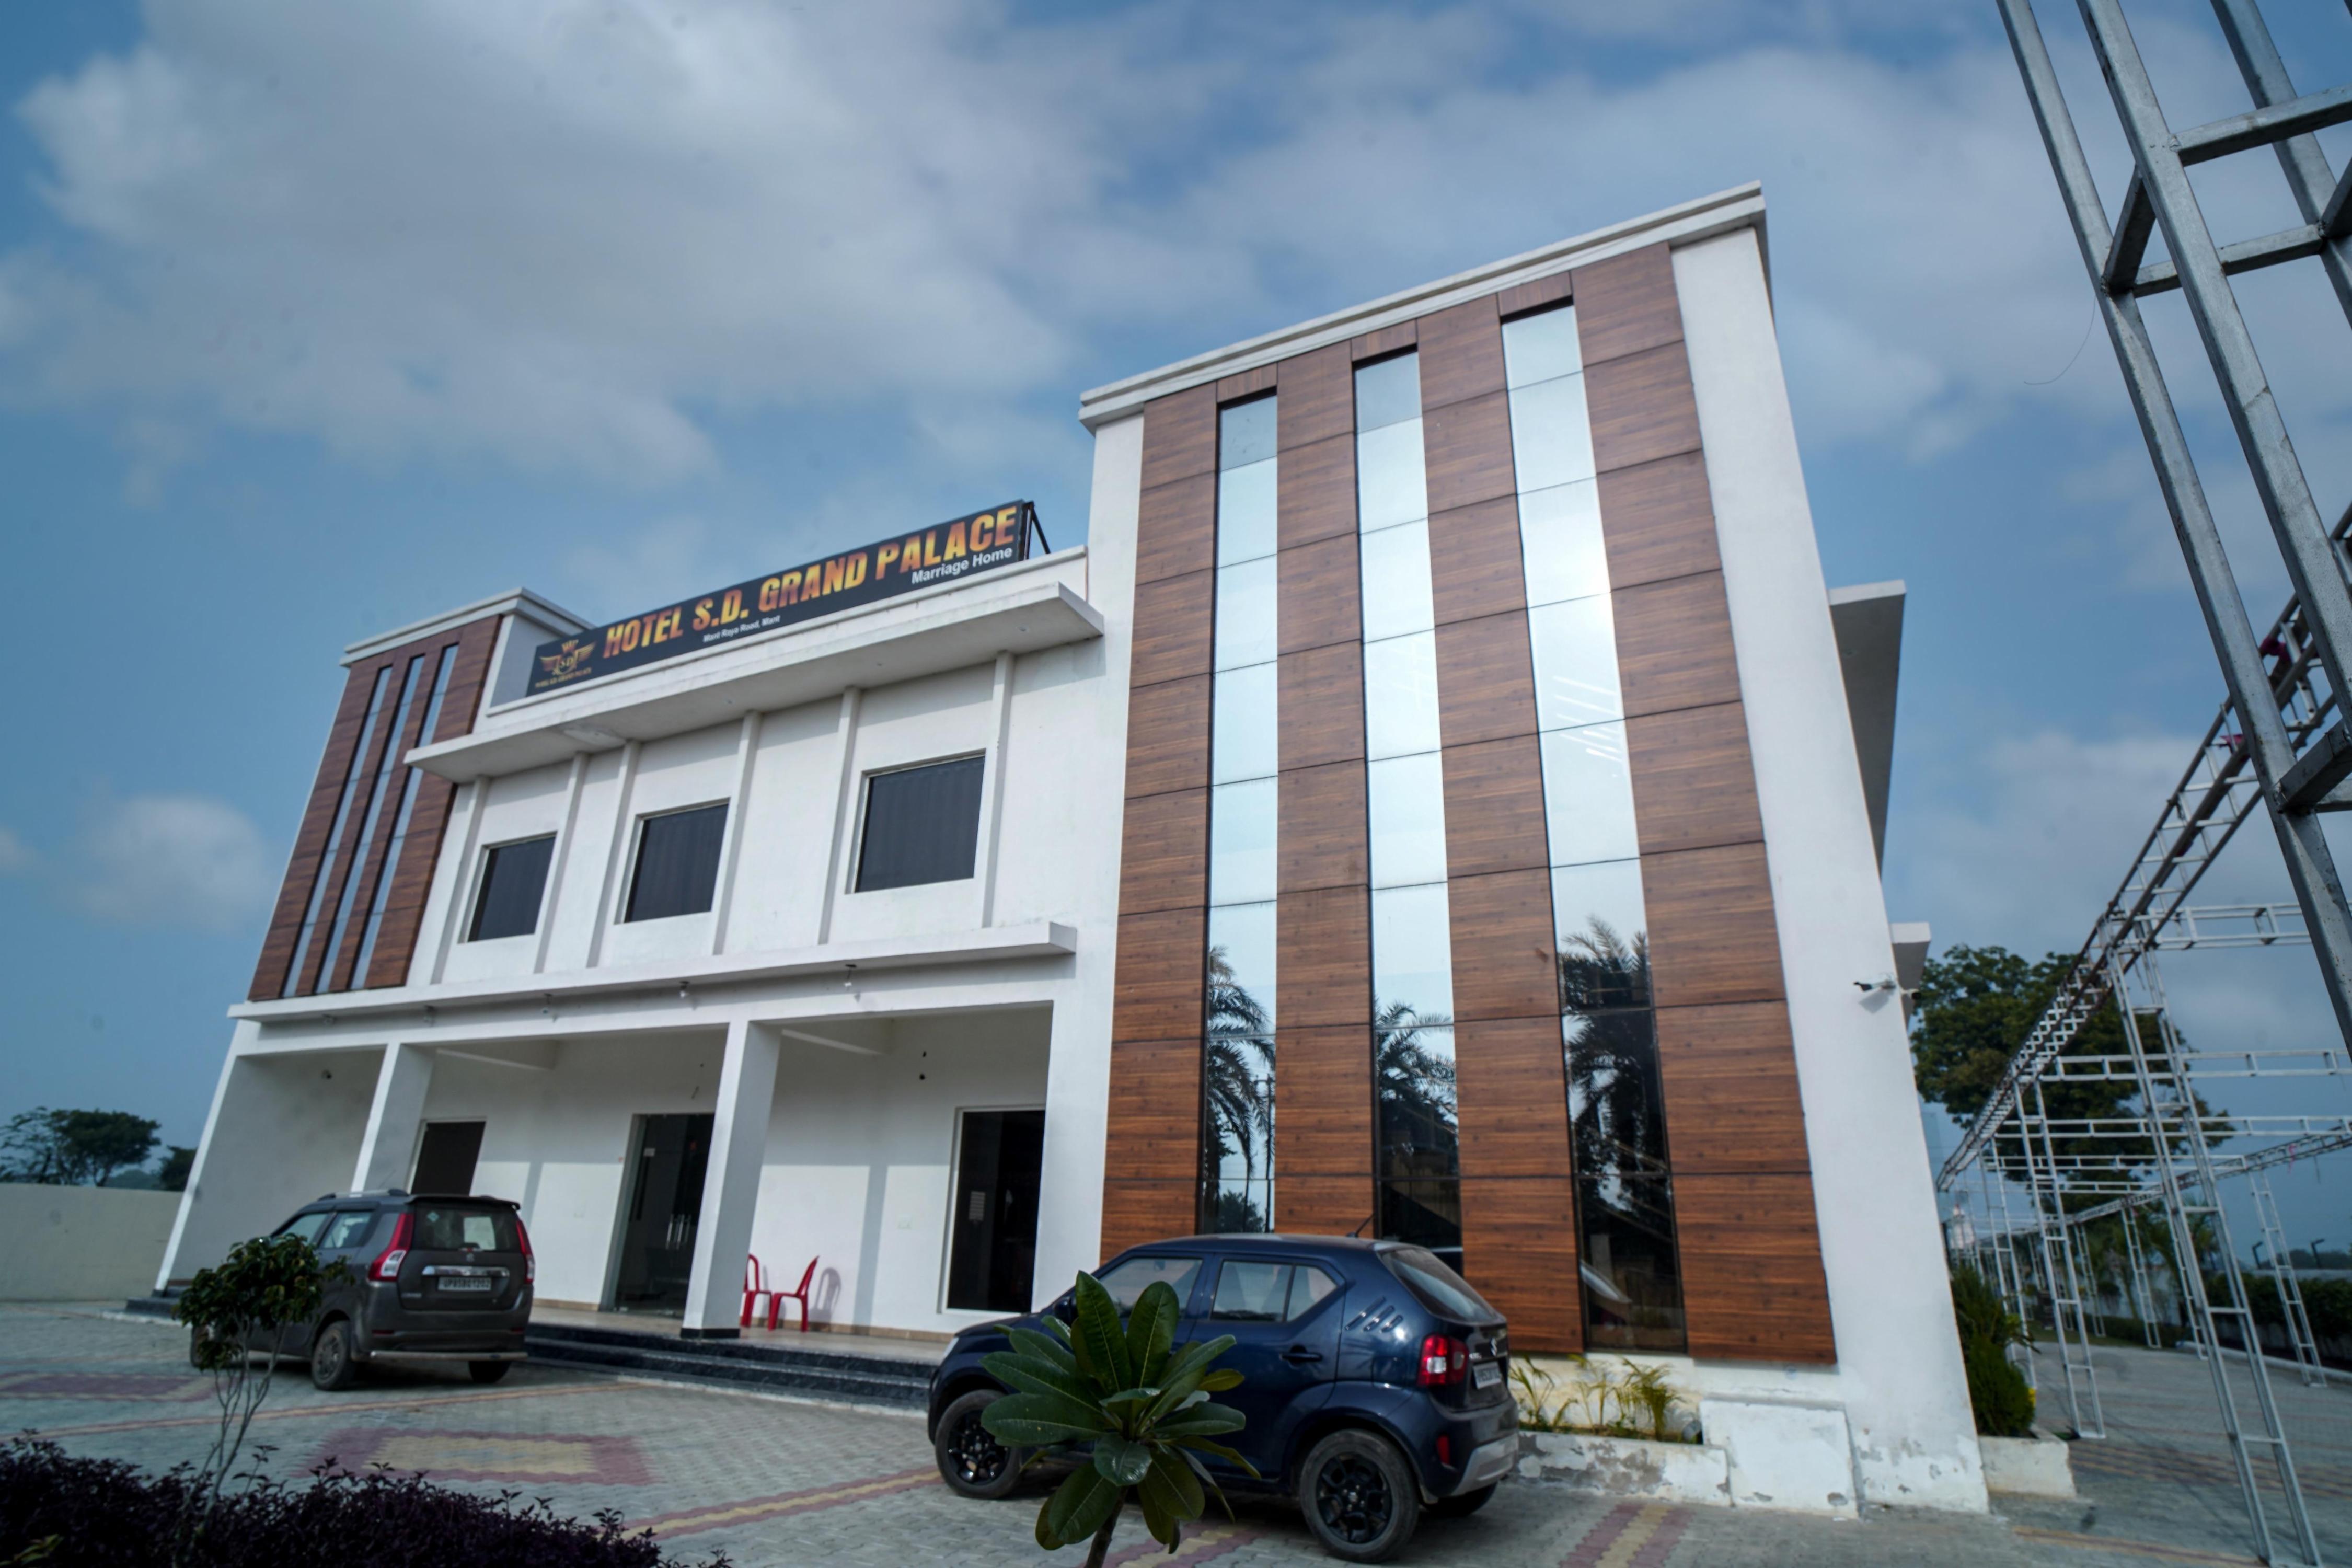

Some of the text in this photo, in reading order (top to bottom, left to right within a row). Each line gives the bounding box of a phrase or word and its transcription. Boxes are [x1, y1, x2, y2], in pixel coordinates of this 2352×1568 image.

[603, 505, 1017, 659] HOTEL S.D. GRAND PALACE
[911, 547, 1013, 585] Marriage Home
